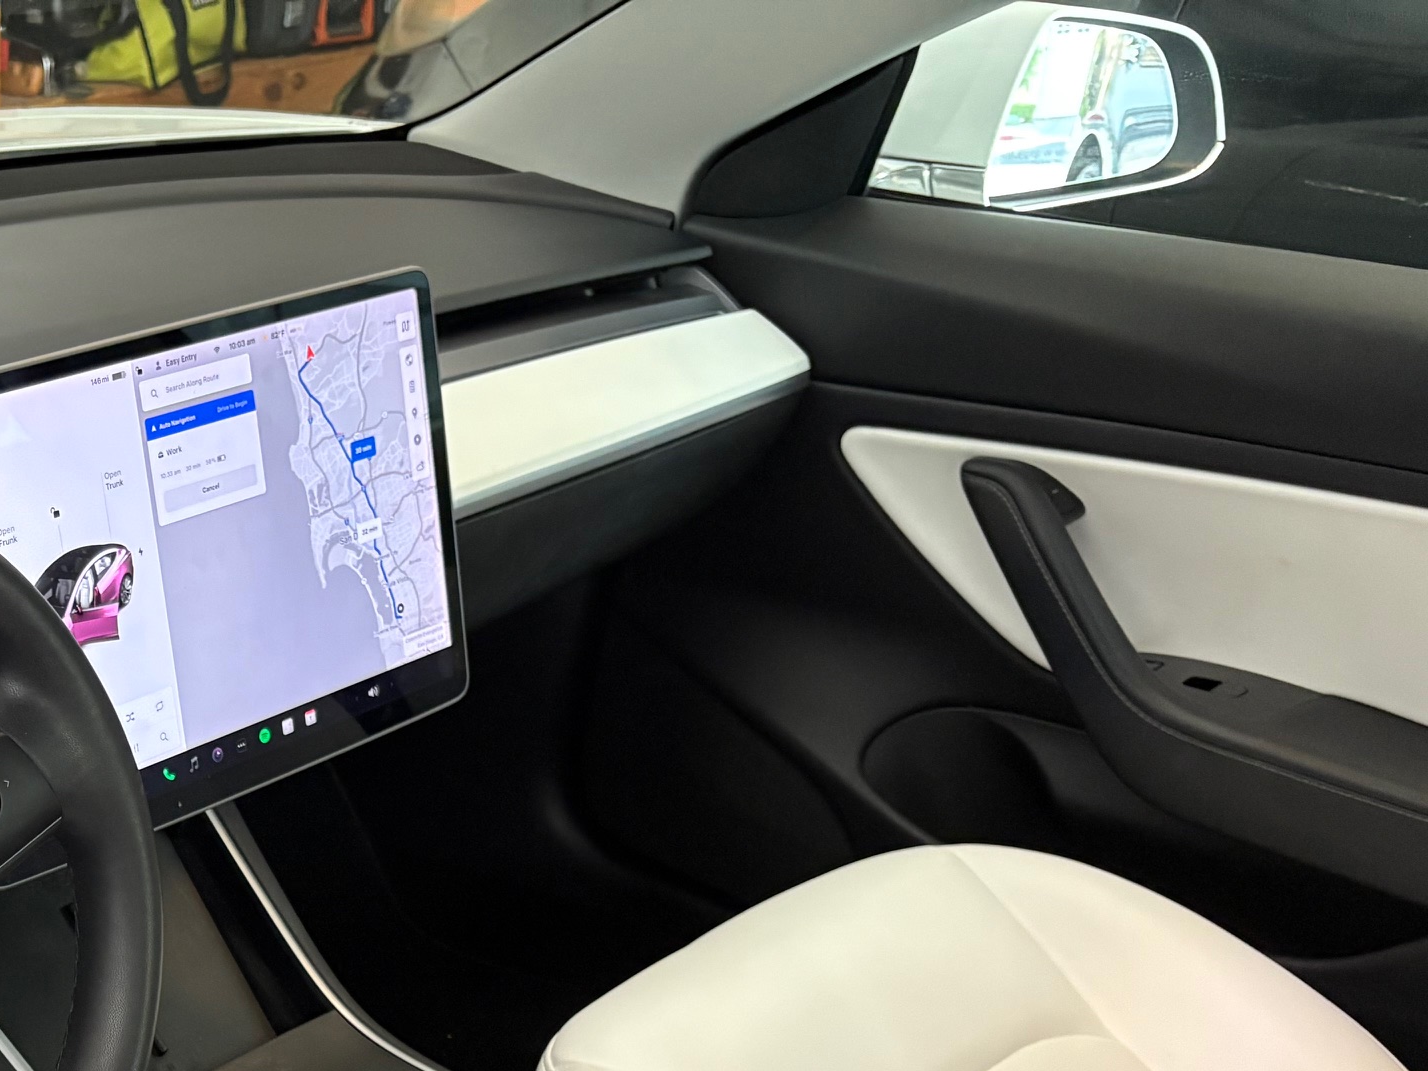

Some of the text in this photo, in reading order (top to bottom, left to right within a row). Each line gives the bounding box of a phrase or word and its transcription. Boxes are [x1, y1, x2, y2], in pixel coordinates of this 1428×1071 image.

[229, 338, 256, 351] 10:03 am
[165, 353, 197, 367] Easy Entry
[102, 374, 110, 383] mi
[165, 374, 219, 394] Search Along Route
[171, 415, 197, 426] Navigation
[165, 445, 183, 456] Work
[104, 470, 122, 480] Open
[105, 478, 124, 491] Trunk
[202, 482, 220, 494] Cancel
